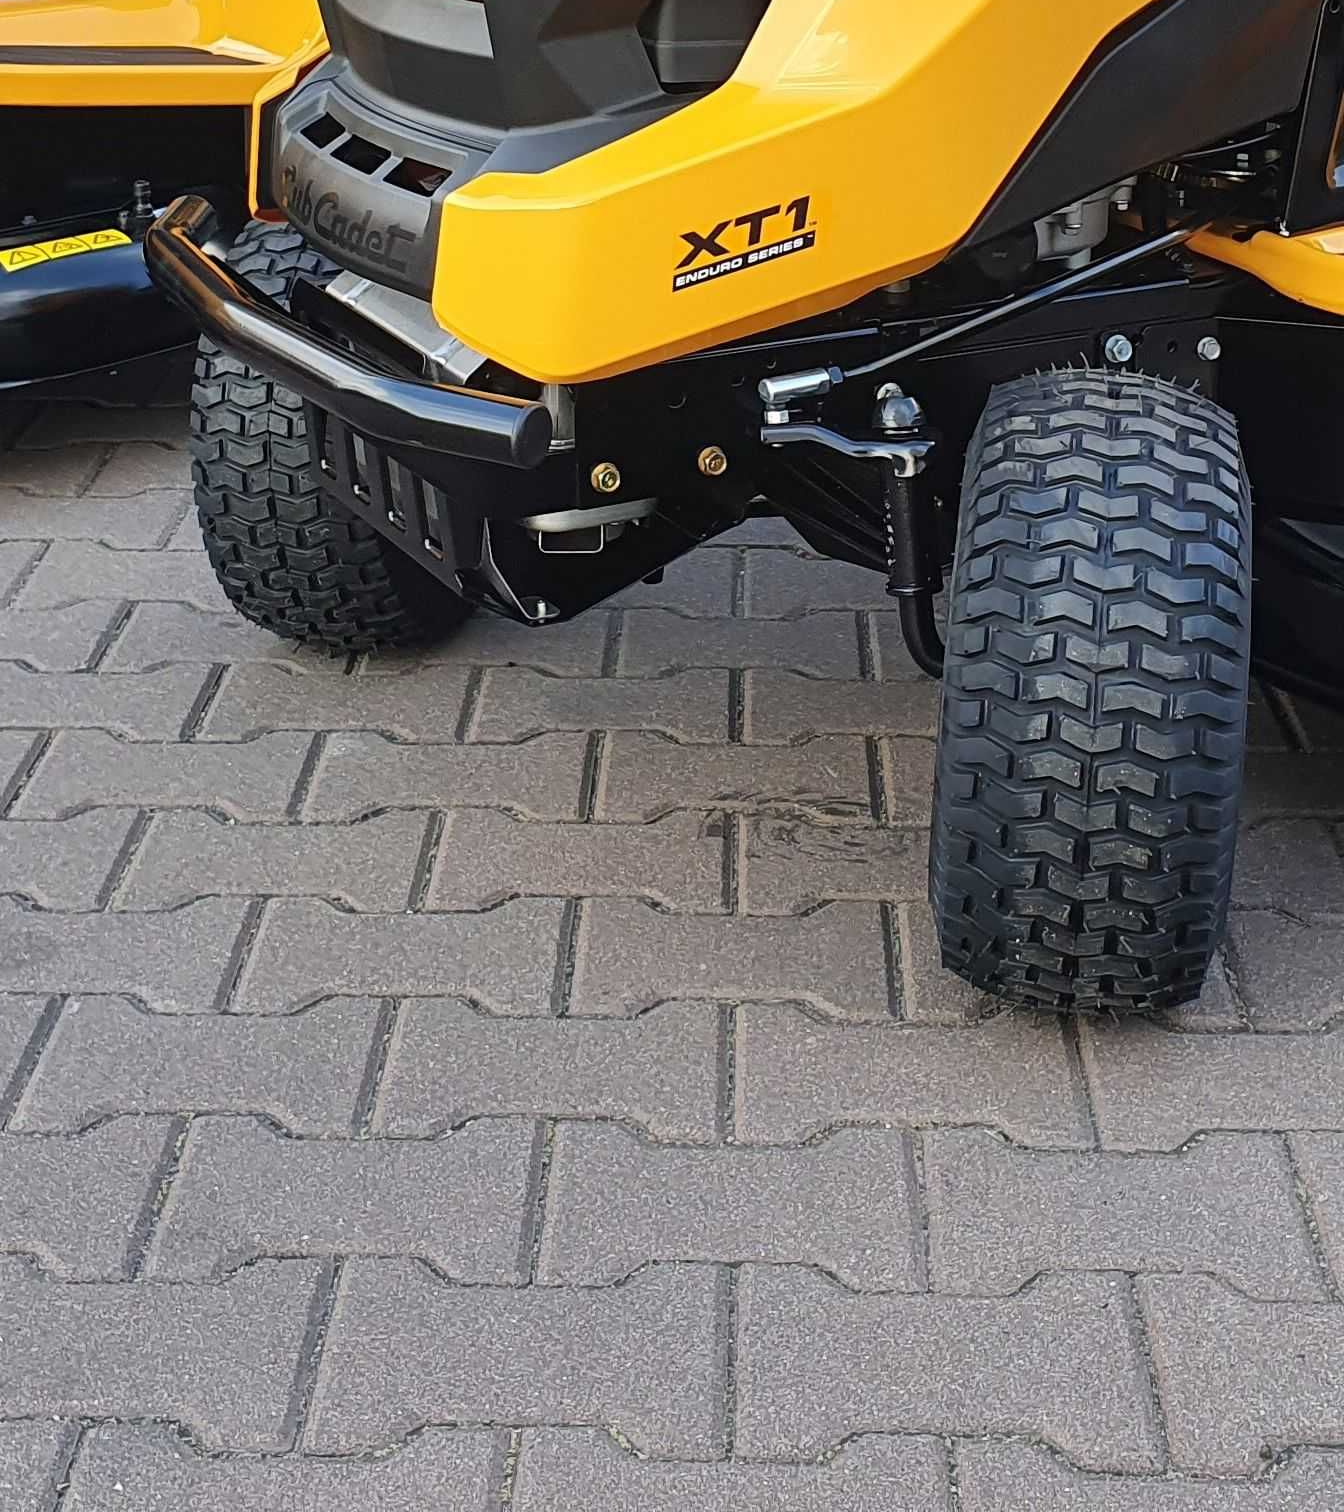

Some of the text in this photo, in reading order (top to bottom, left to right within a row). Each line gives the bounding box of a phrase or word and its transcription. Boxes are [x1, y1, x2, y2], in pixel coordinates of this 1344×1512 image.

[673, 194, 811, 271] XT1
[675, 236, 804, 287] ENDURO SERIES
